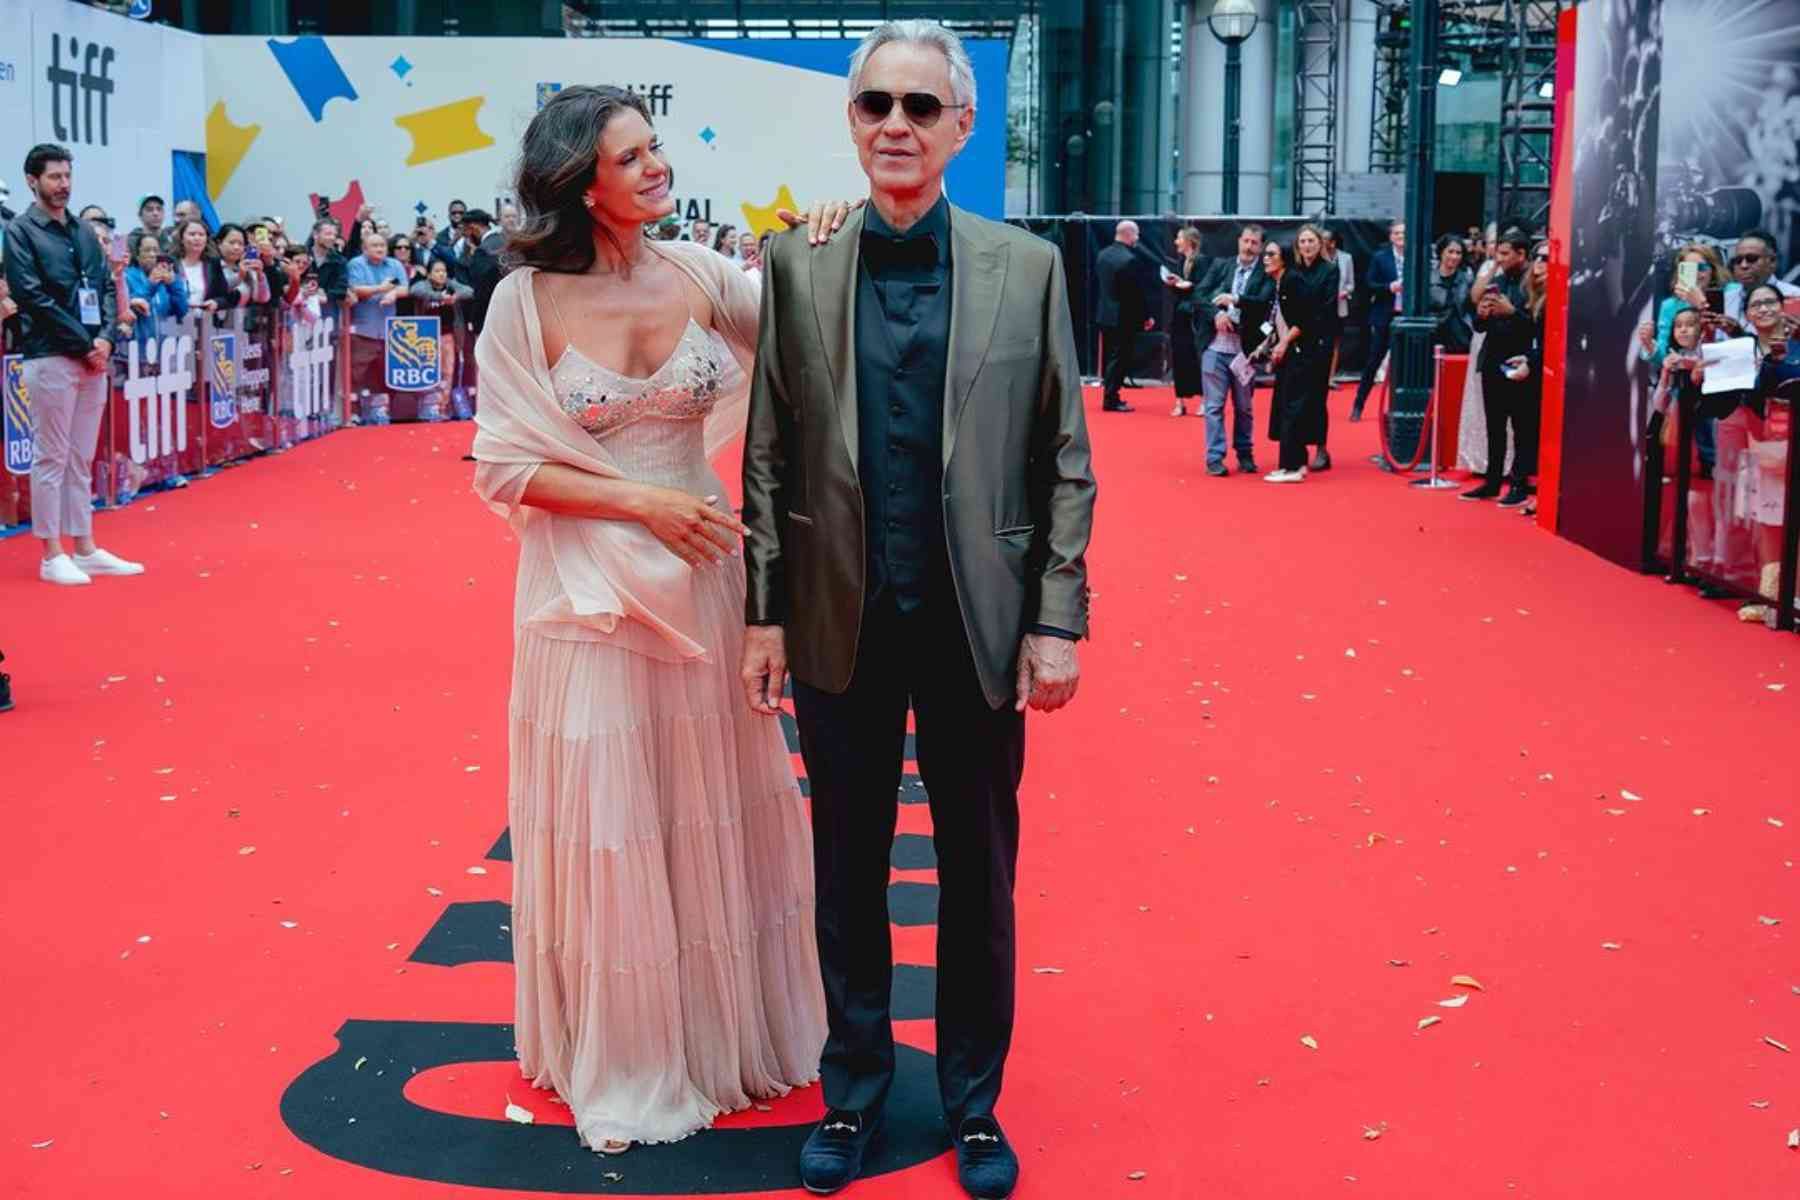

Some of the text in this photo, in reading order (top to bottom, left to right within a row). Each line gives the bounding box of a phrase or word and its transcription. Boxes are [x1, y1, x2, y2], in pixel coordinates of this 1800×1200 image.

[47, 33, 115, 146] tiff
[124, 335, 193, 464] tiff
[391, 368, 435, 385] RBC
[9, 438, 33, 466] RB
